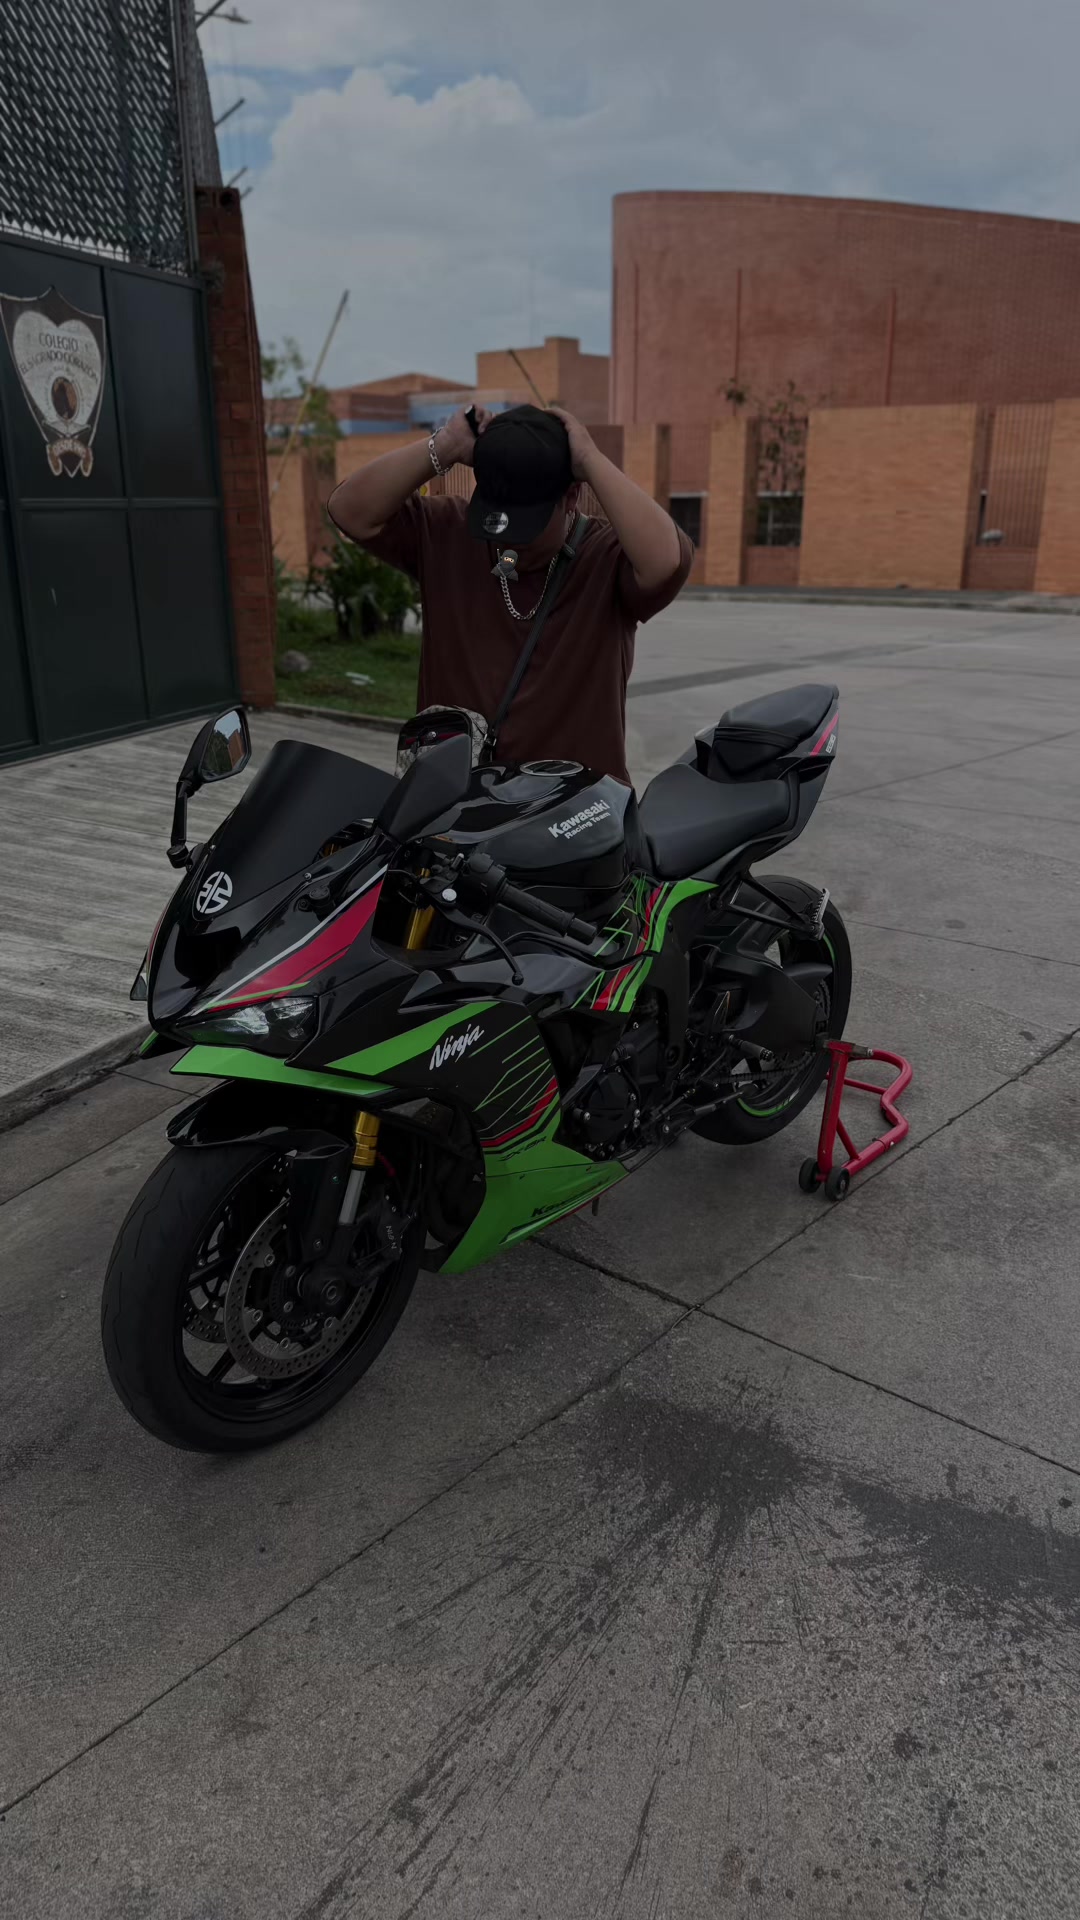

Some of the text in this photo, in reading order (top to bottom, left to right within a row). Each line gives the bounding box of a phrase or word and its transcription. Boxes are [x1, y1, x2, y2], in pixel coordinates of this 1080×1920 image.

[38, 332, 79, 352] COLEGIO
[547, 799, 611, 839] Kawasaki
[564, 811, 611, 840] Racing Team
[429, 1023, 485, 1071] Ninja
